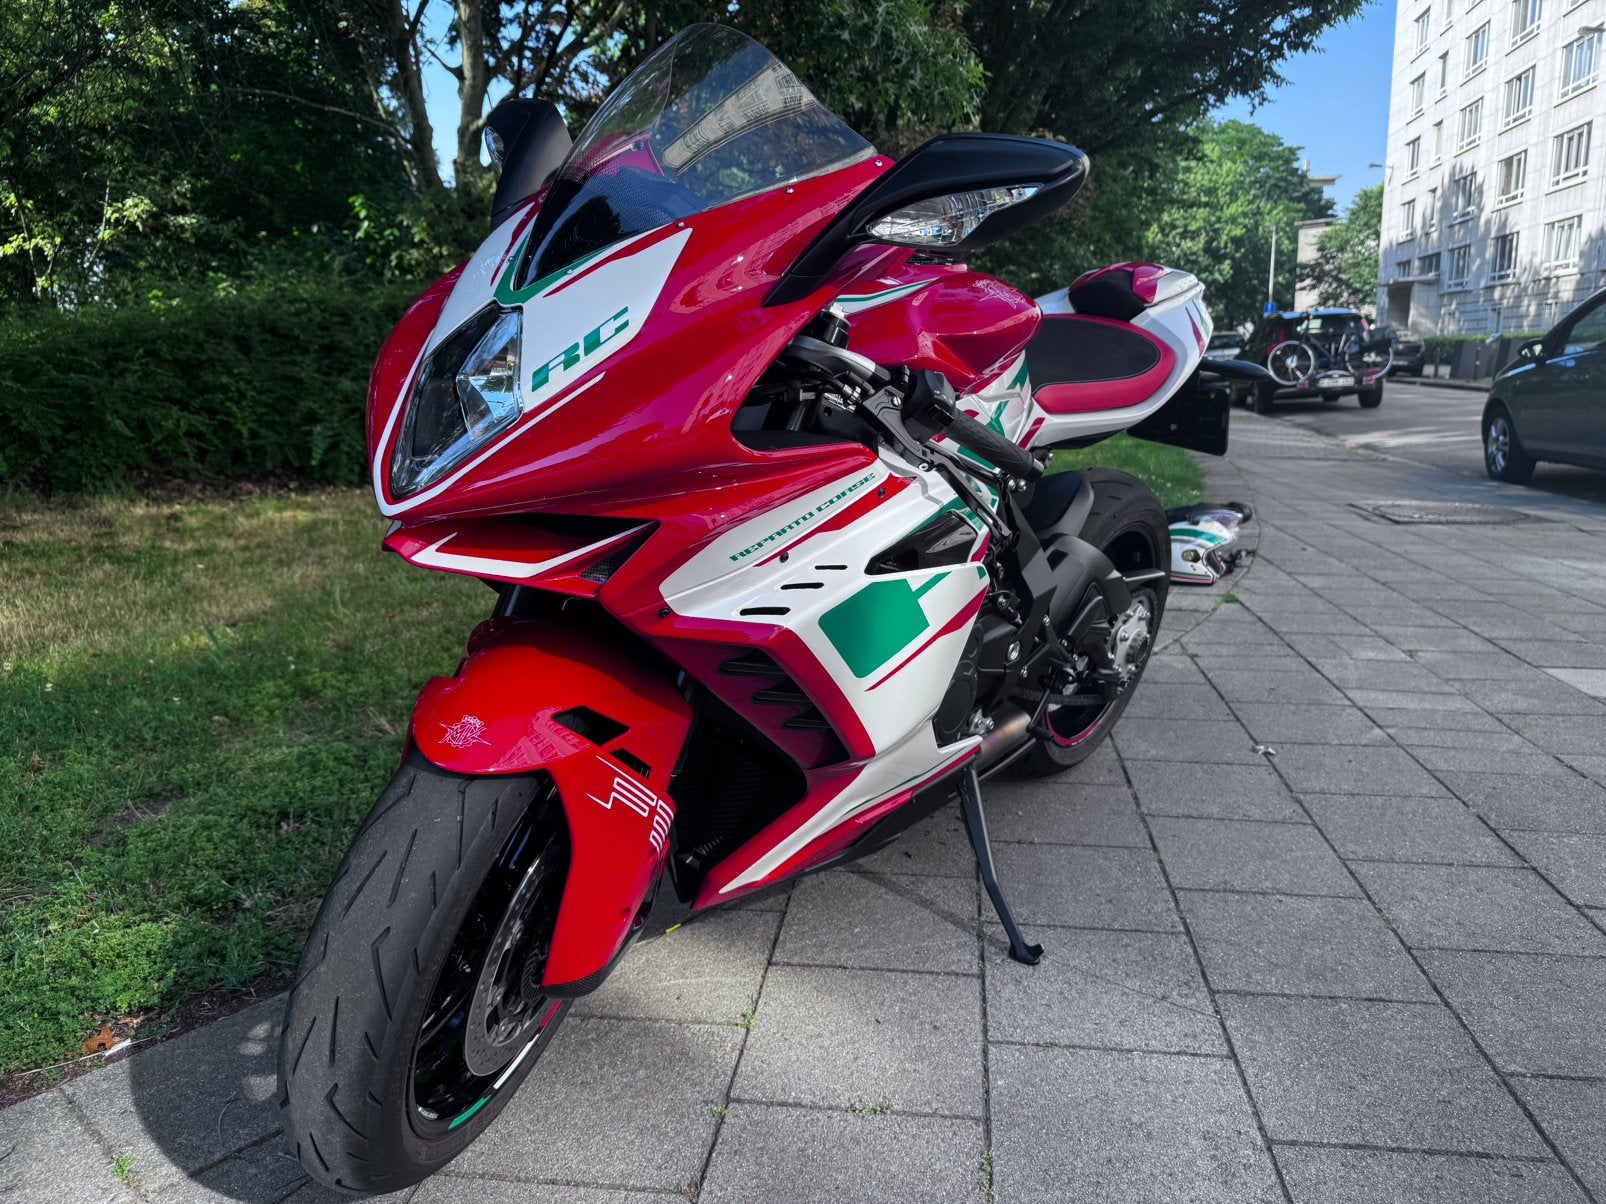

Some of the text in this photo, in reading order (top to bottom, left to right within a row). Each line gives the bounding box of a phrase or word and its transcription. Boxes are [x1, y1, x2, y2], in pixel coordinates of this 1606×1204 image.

[531, 305, 630, 393] RC
[729, 472, 876, 562] REPARTO CORSE
